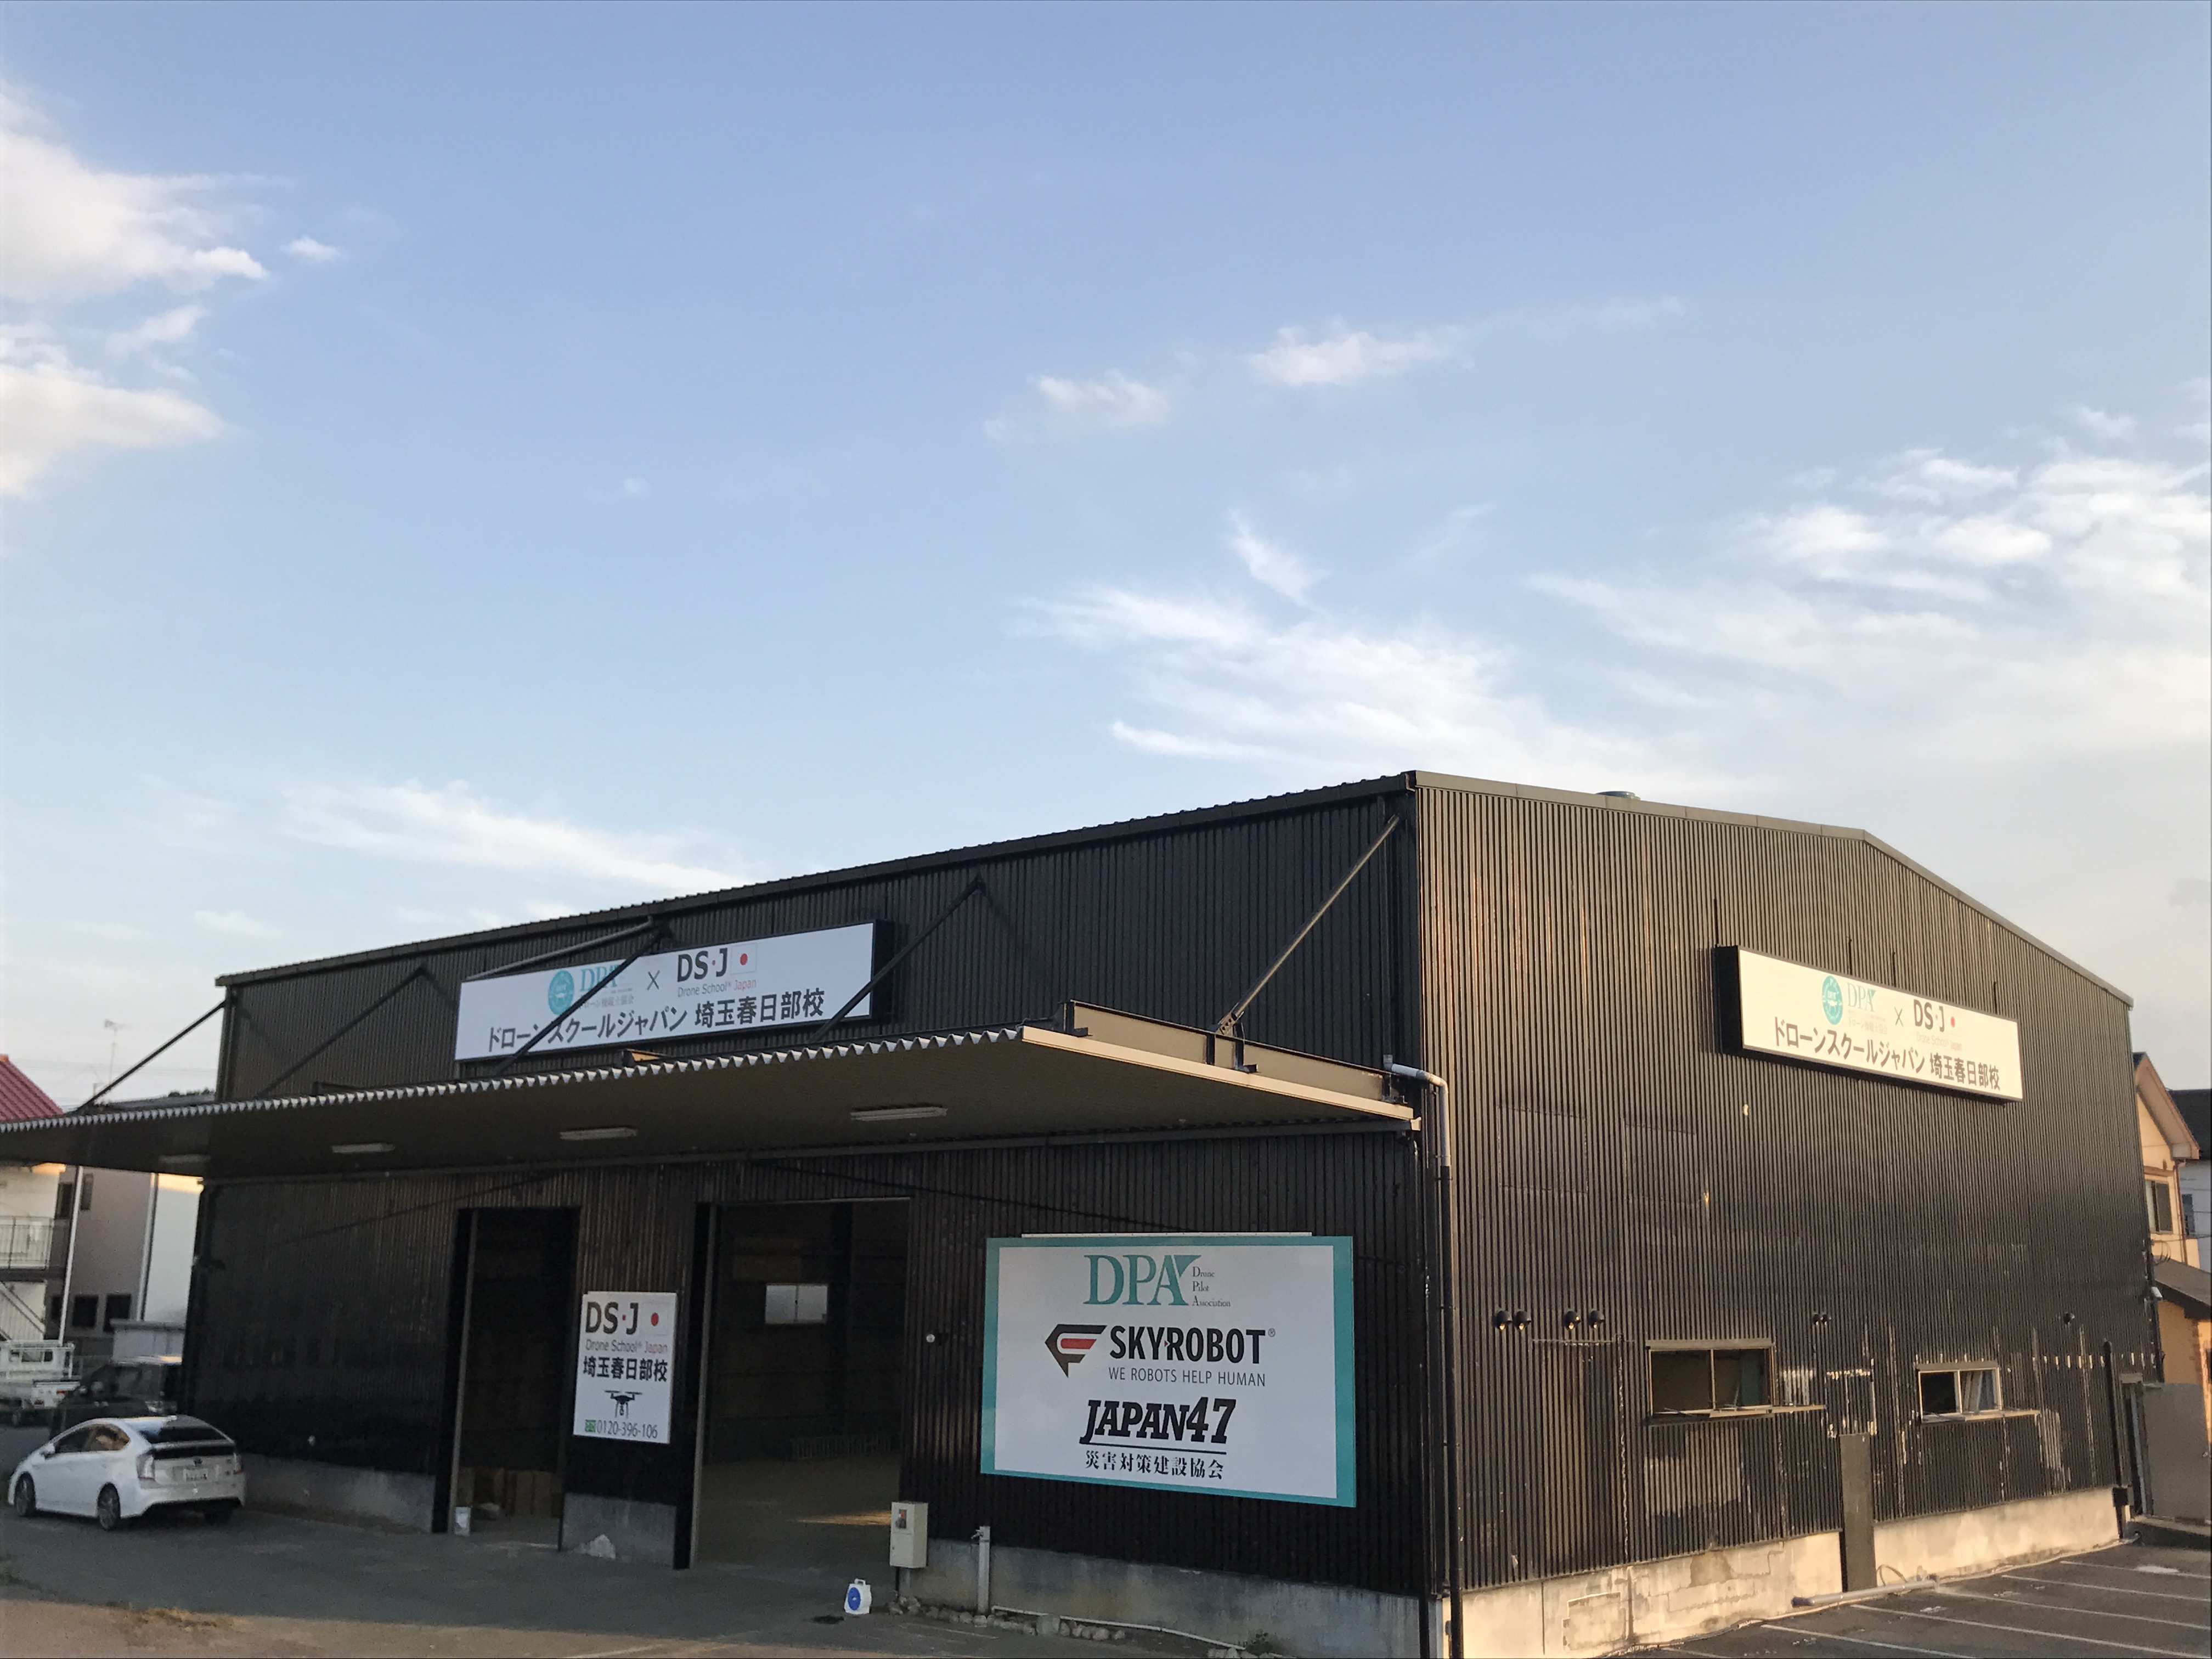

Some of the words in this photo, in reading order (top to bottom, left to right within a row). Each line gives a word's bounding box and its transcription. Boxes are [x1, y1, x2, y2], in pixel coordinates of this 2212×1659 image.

[678, 986, 699, 997] Drone
[733, 979, 757, 991] Japan
[1846, 982, 1877, 1013] DPA
[488, 1006, 687, 1052] ドロースクールジャパン
[695, 988, 825, 1028] 埼玉春日部校
[1775, 1017, 1925, 1074] ドローンスクールジャパン
[1929, 1052, 2000, 1090] 埼玉春日部校
[1083, 1254, 1201, 1306] DPA
[1192, 1266, 1215, 1277] Drone
[1192, 1281, 1209, 1291] Pilot
[1192, 1295, 1231, 1307] Association
[583, 1356, 668, 1382] 埼玉春日部校
[1109, 1367, 1125, 1380] WE
[1131, 1368, 1177, 1382] ROBOTS
[1183, 1370, 1212, 1384] HELP
[1218, 1372, 1265, 1386] HUMAN
[597, 1420, 658, 1438] 0120-396-106
[1079, 1397, 1236, 1444] JAPAN47
[1085, 1450, 1223, 1480] 災害対策建設協会
